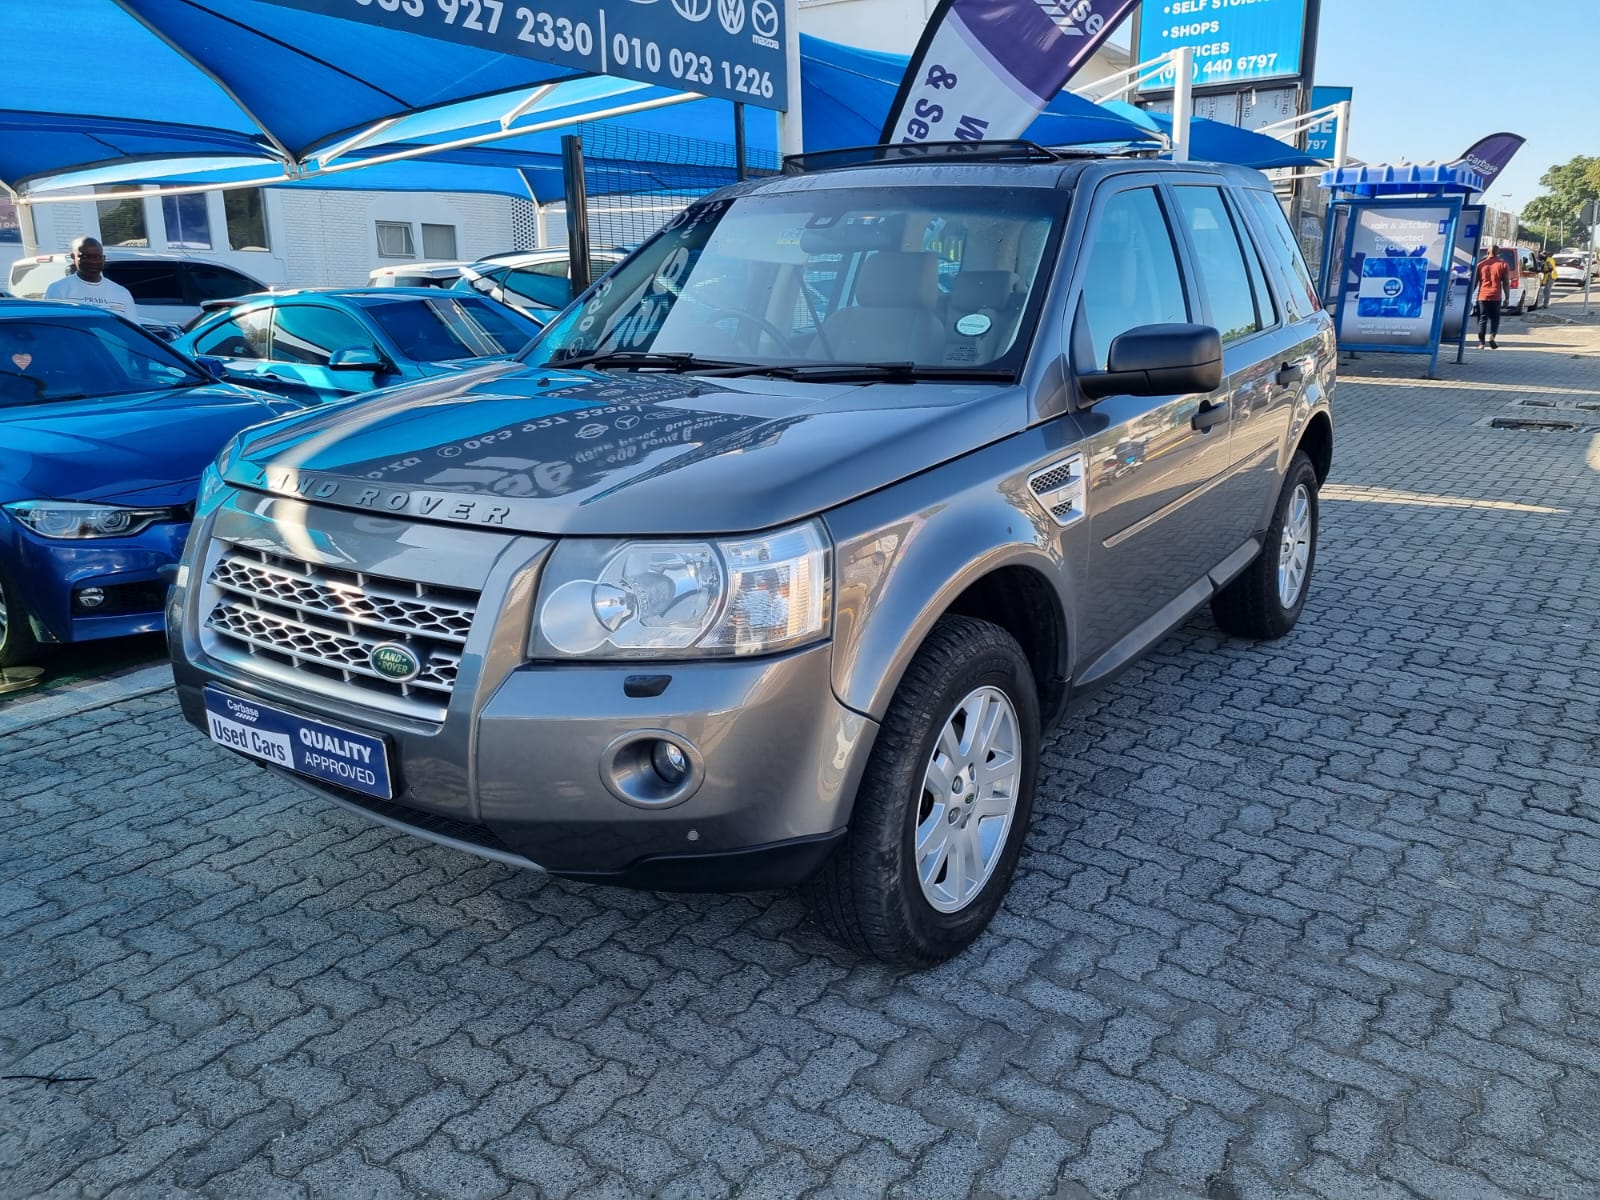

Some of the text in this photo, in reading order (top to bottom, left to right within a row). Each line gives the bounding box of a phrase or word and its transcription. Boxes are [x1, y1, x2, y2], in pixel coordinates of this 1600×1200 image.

[515, 6, 593, 56] 2330
[1170, 20, 1219, 38] SHOPS
[752, 34, 779, 50] mazda
[613, 33, 774, 99] 010 023 1226
[1203, 58, 1232, 74] 440
[1237, 52, 1278, 70] 6797
[925, 64, 957, 90] &
[1466, 153, 1499, 173] Carbase
[250, 469, 512, 525] LAND ROVER
[380, 651, 402, 662] LAND
[381, 660, 408, 674] ROVER
[227, 699, 260, 718] Carbase
[213, 718, 286, 762] Used Cars
[300, 727, 372, 764] QUALITY
[305, 752, 376, 786] APPROVED
